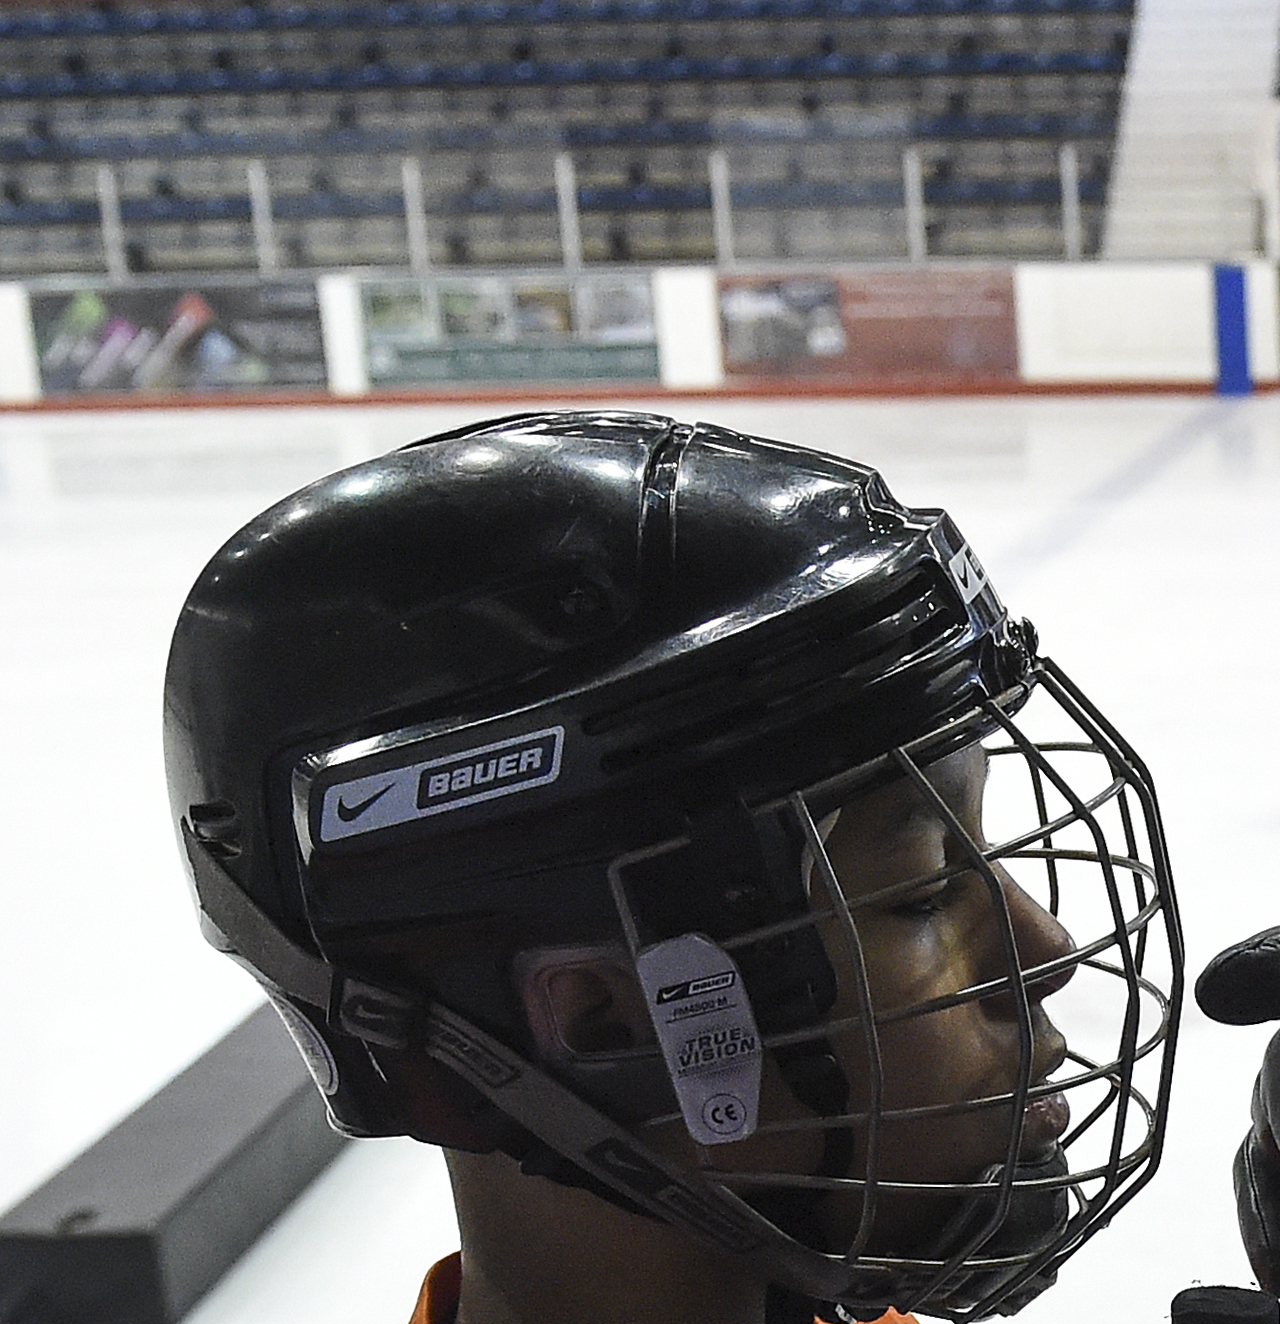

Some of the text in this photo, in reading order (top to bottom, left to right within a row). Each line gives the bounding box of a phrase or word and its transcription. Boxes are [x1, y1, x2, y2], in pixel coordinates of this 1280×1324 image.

[428, 747, 543, 798] BAUER
[679, 1037, 756, 1068] VISION
[685, 1028, 741, 1053] TRUE
[711, 1103, 738, 1125] CE
